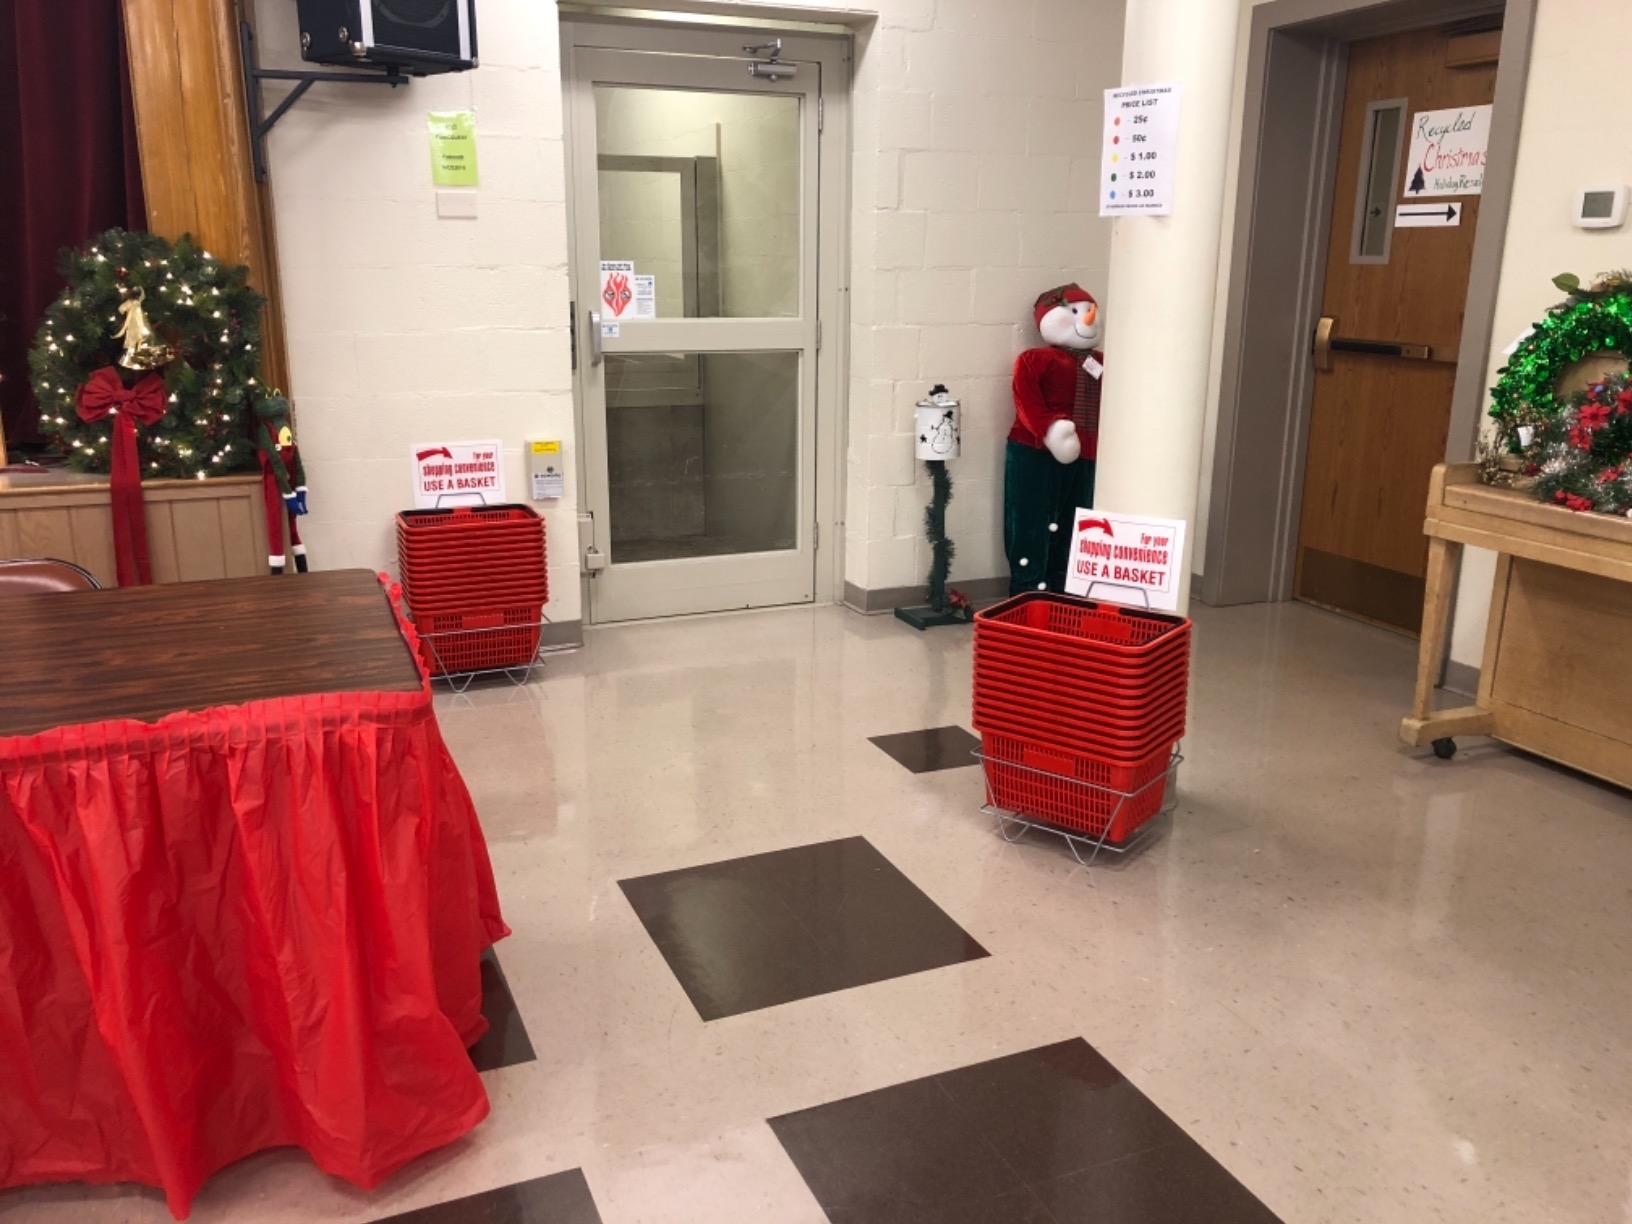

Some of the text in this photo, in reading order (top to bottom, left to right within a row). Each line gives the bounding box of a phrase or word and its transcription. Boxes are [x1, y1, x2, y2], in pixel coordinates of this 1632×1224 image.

[1121, 98, 1159, 108] PRICE LIST
[1417, 112, 1477, 150] Recycled
[1423, 143, 1487, 172] Christmas
[423, 461, 495, 477] shopping convenience
[424, 476, 496, 491] USE A BASKET
[1140, 532, 1169, 547] For your
[1080, 538, 1168, 565] shopping convenience
[1076, 560, 1166, 586] USE A BASKET
